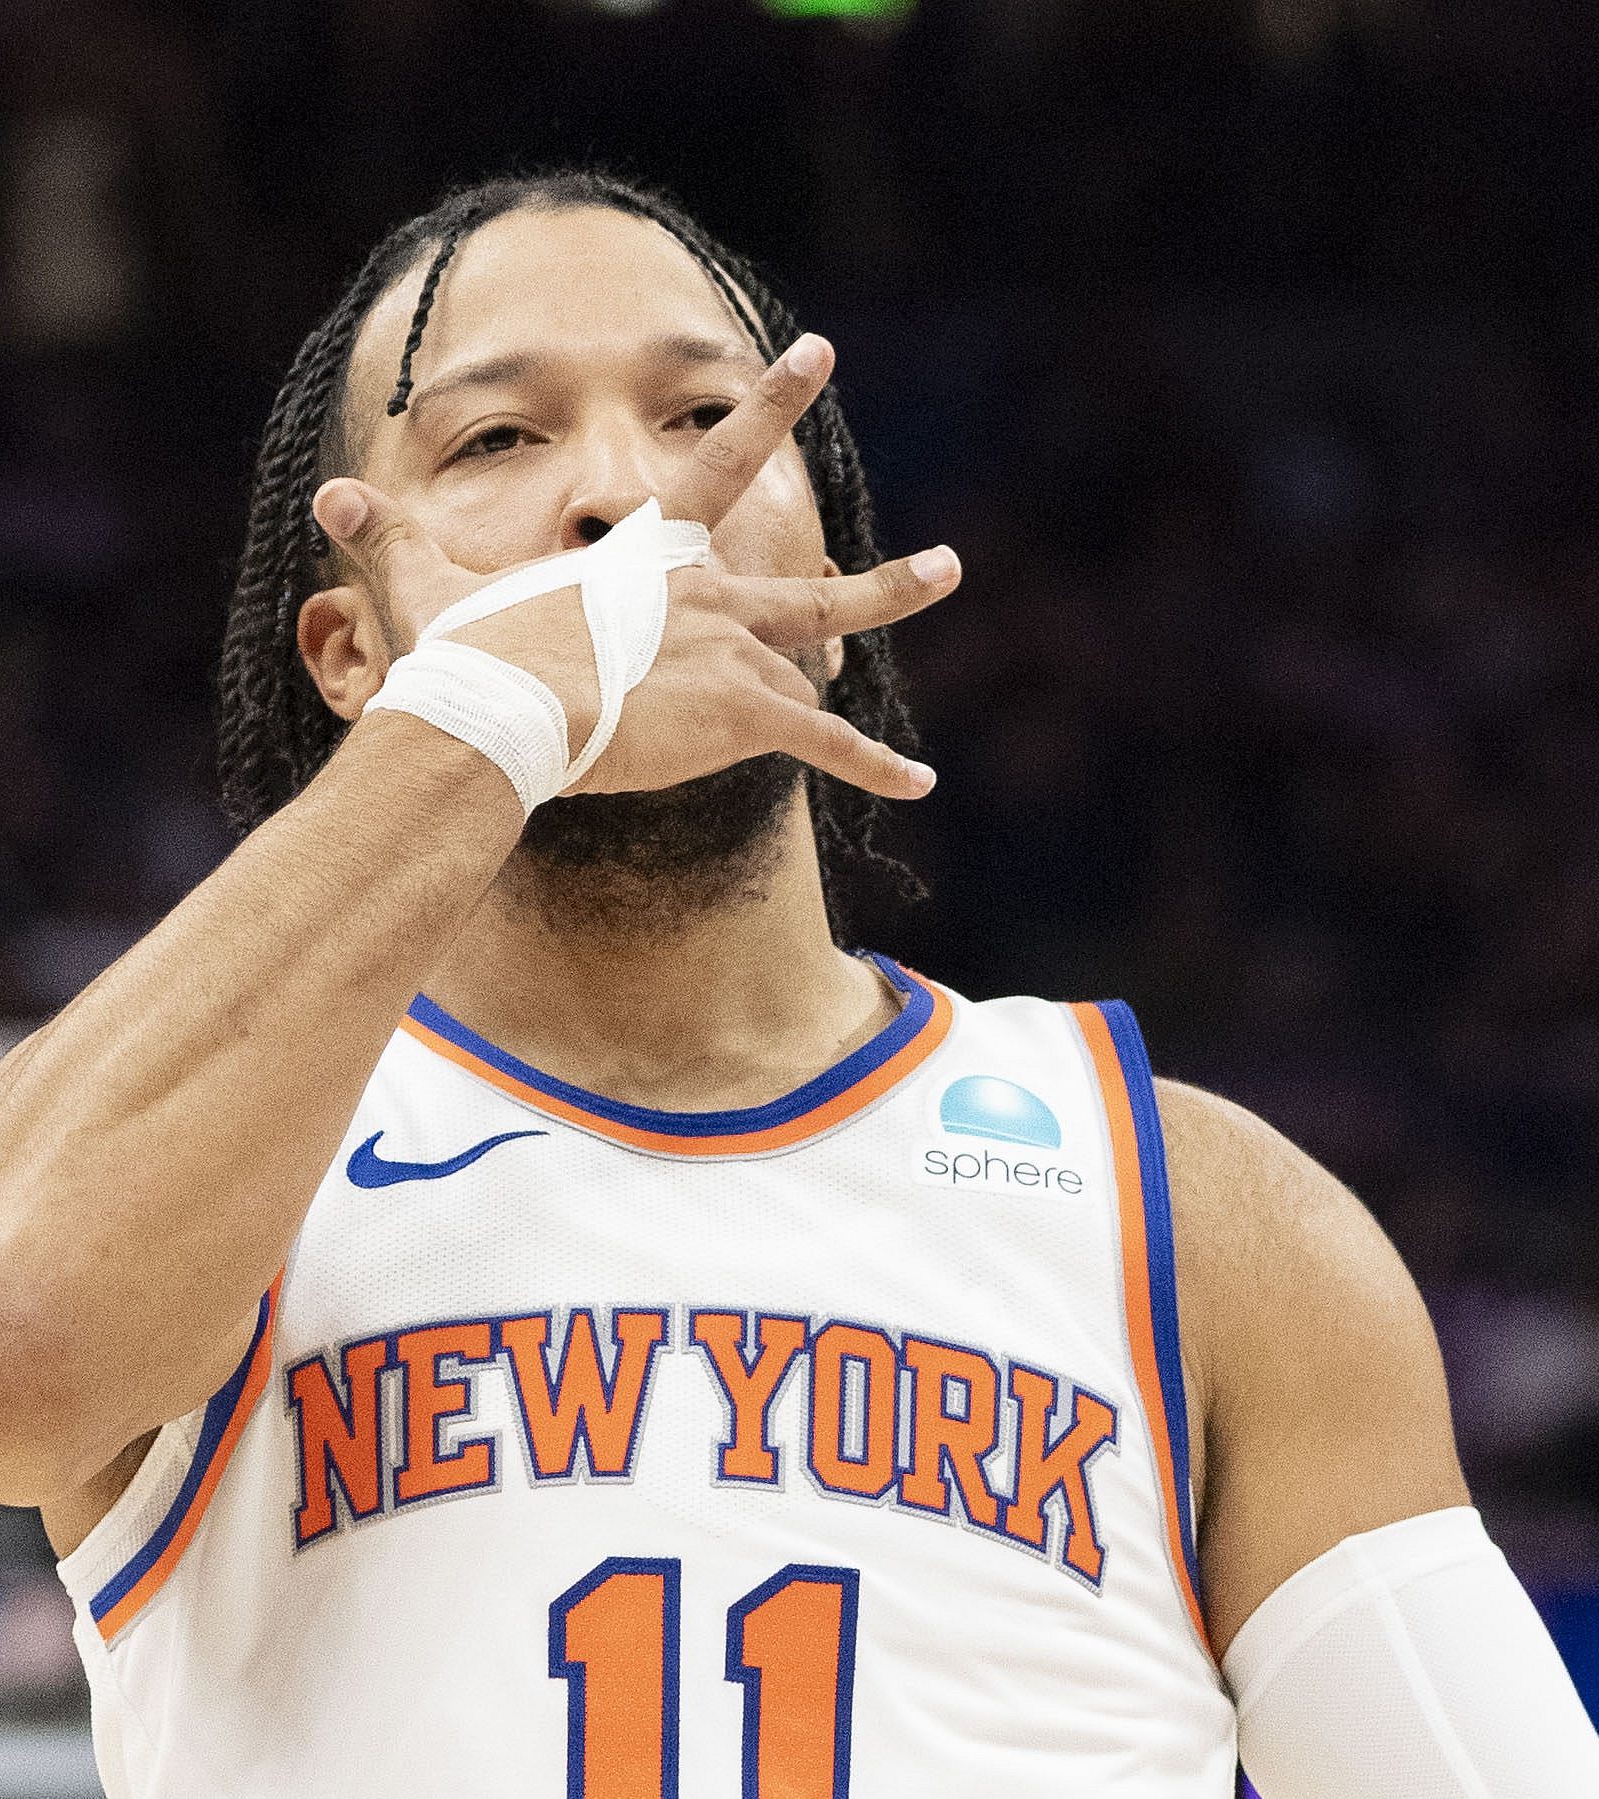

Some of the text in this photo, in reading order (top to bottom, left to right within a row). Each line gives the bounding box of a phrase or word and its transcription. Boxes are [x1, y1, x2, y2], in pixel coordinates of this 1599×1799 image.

[924, 1148, 1083, 1195] sphere
[286, 1307, 1119, 1597] NEW YORK
